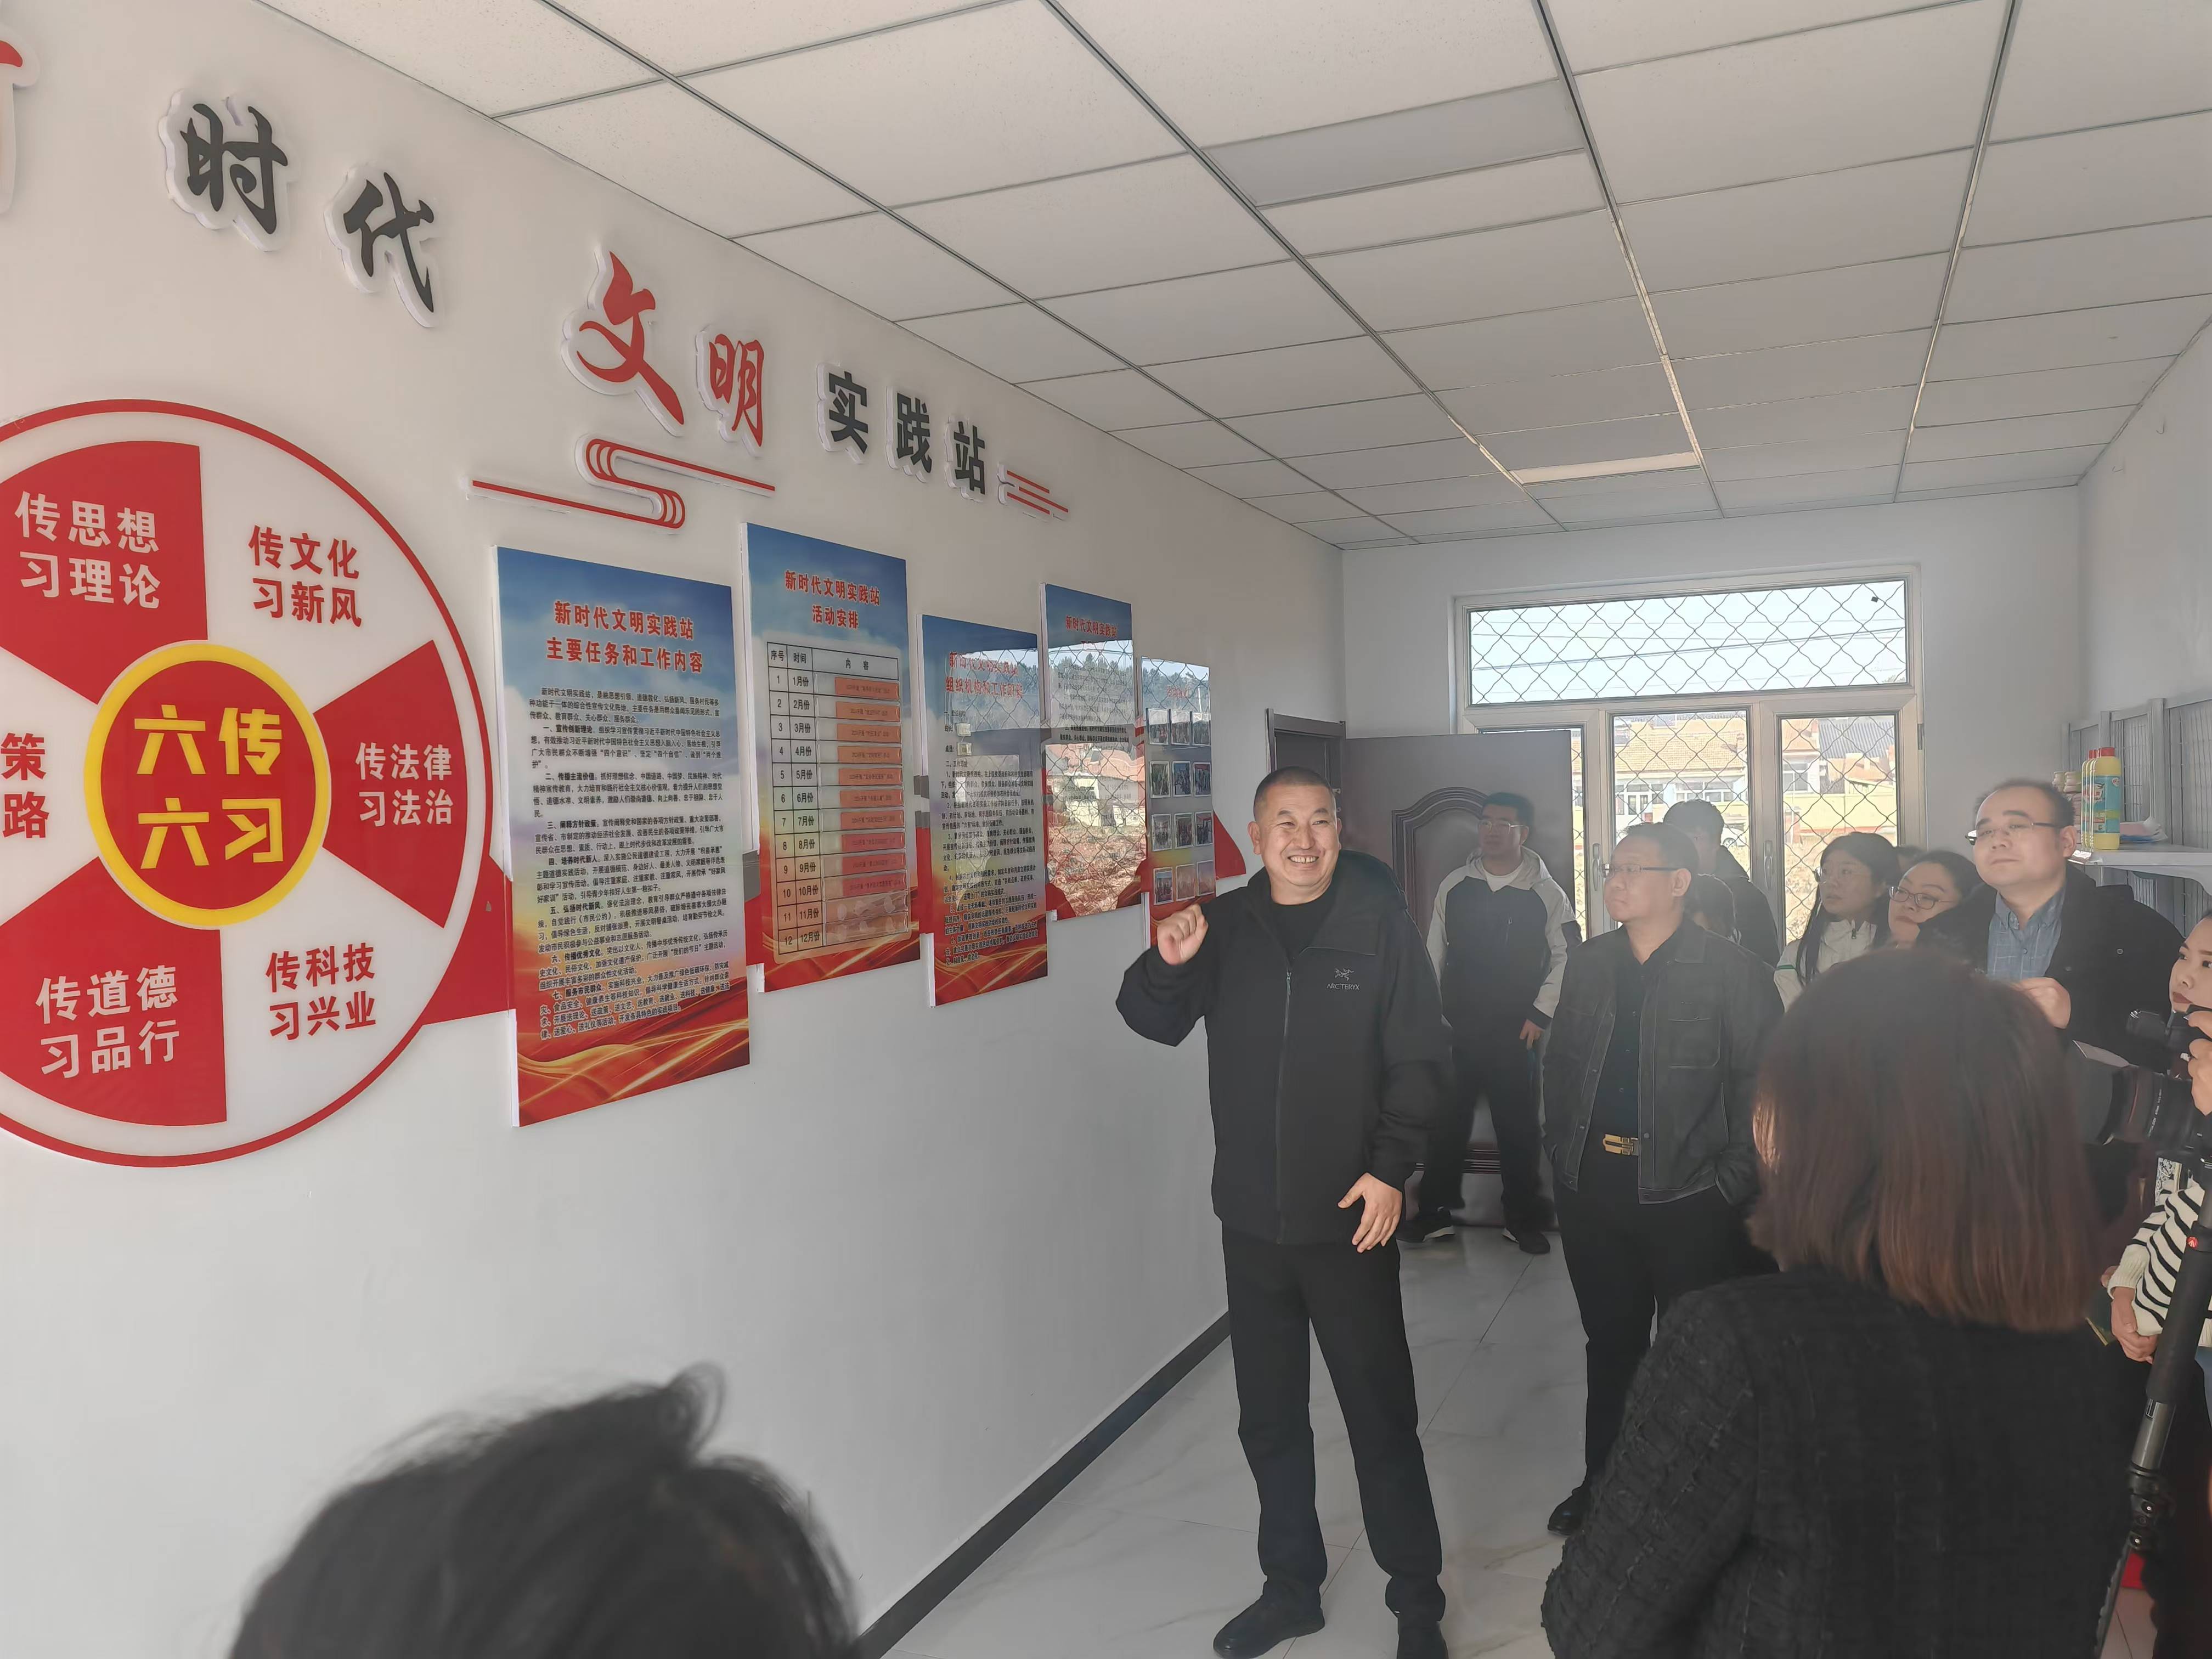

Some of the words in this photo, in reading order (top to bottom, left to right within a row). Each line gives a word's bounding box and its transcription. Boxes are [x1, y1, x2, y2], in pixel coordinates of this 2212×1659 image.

[180, 103, 435, 313] 时代
[577, 250, 765, 447] 文明
[828, 370, 986, 495] 实践站
[14, 490, 160, 554] 传思想
[249, 524, 360, 580] 传文化
[19, 550, 160, 609] 习理论
[785, 570, 880, 606] 新时代文明实践站
[252, 577, 362, 627] 习新风
[555, 600, 694, 641] 新时代文明实践站
[812, 605, 859, 630] 活动安排
[546, 637, 703, 673] 主要任务和工作内容
[771, 649, 785, 662] 序号
[793, 652, 806, 664] 时间
[777, 675, 780, 684] 1
[793, 676, 809, 687] 1月份
[777, 699, 782, 708] 2
[793, 699, 810, 710] 2月份
[778, 723, 783, 731] 3
[794, 723, 811, 734] 3月份
[134, 704, 283, 775] 六传
[779, 746, 783, 755] 4
[795, 747, 812, 757] 4月份
[0, 733, 47, 780] 策
[355, 742, 452, 781] 传法律
[780, 770, 785, 780] 5
[796, 770, 812, 780] 5月份
[781, 794, 786, 803] 6
[797, 792, 814, 803] 6月份
[358, 788, 453, 827] 习法治
[2, 792, 50, 839] 路
[798, 816, 814, 826] 7月份
[782, 818, 786, 827] 7
[138, 797, 284, 870] 六习
[783, 842, 787, 850] 8
[799, 839, 815, 849] 8月份
[784, 865, 788, 874] 9
[800, 862, 816, 873] 9月份
[783, 889, 791, 898] 10
[799, 885, 819, 896] 10月份
[784, 912, 791, 922] 11
[800, 908, 819, 919] 11月份
[785, 936, 793, 946] 12
[801, 931, 820, 943] 12月份
[265, 943, 375, 993] 传科技
[35, 965, 179, 1024] 传道德
[269, 991, 376, 1041] 习兴业
[40, 1019, 180, 1079] 习品行
